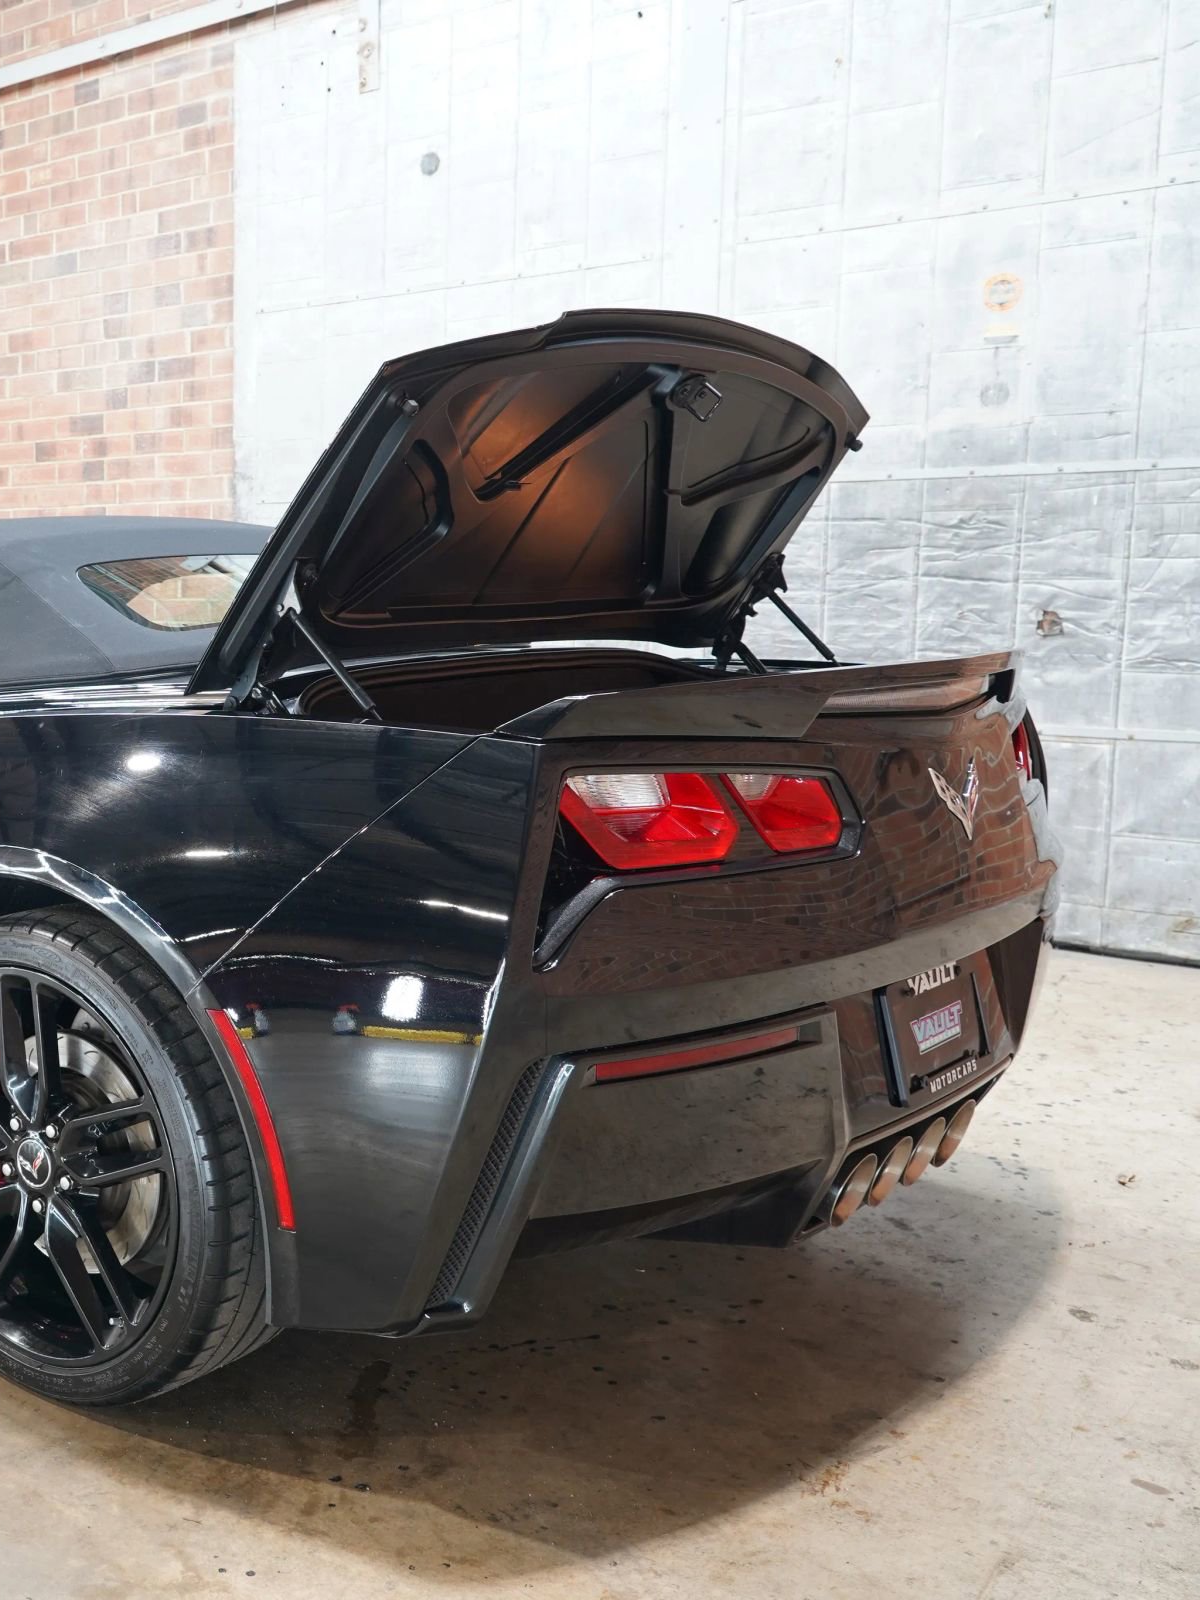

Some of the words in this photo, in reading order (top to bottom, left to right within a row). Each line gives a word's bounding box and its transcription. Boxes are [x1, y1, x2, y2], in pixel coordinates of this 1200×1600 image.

[907, 961, 957, 997] VAULT
[911, 1003, 963, 1043] VAULT
[929, 1058, 978, 1094] MOTORCARS
